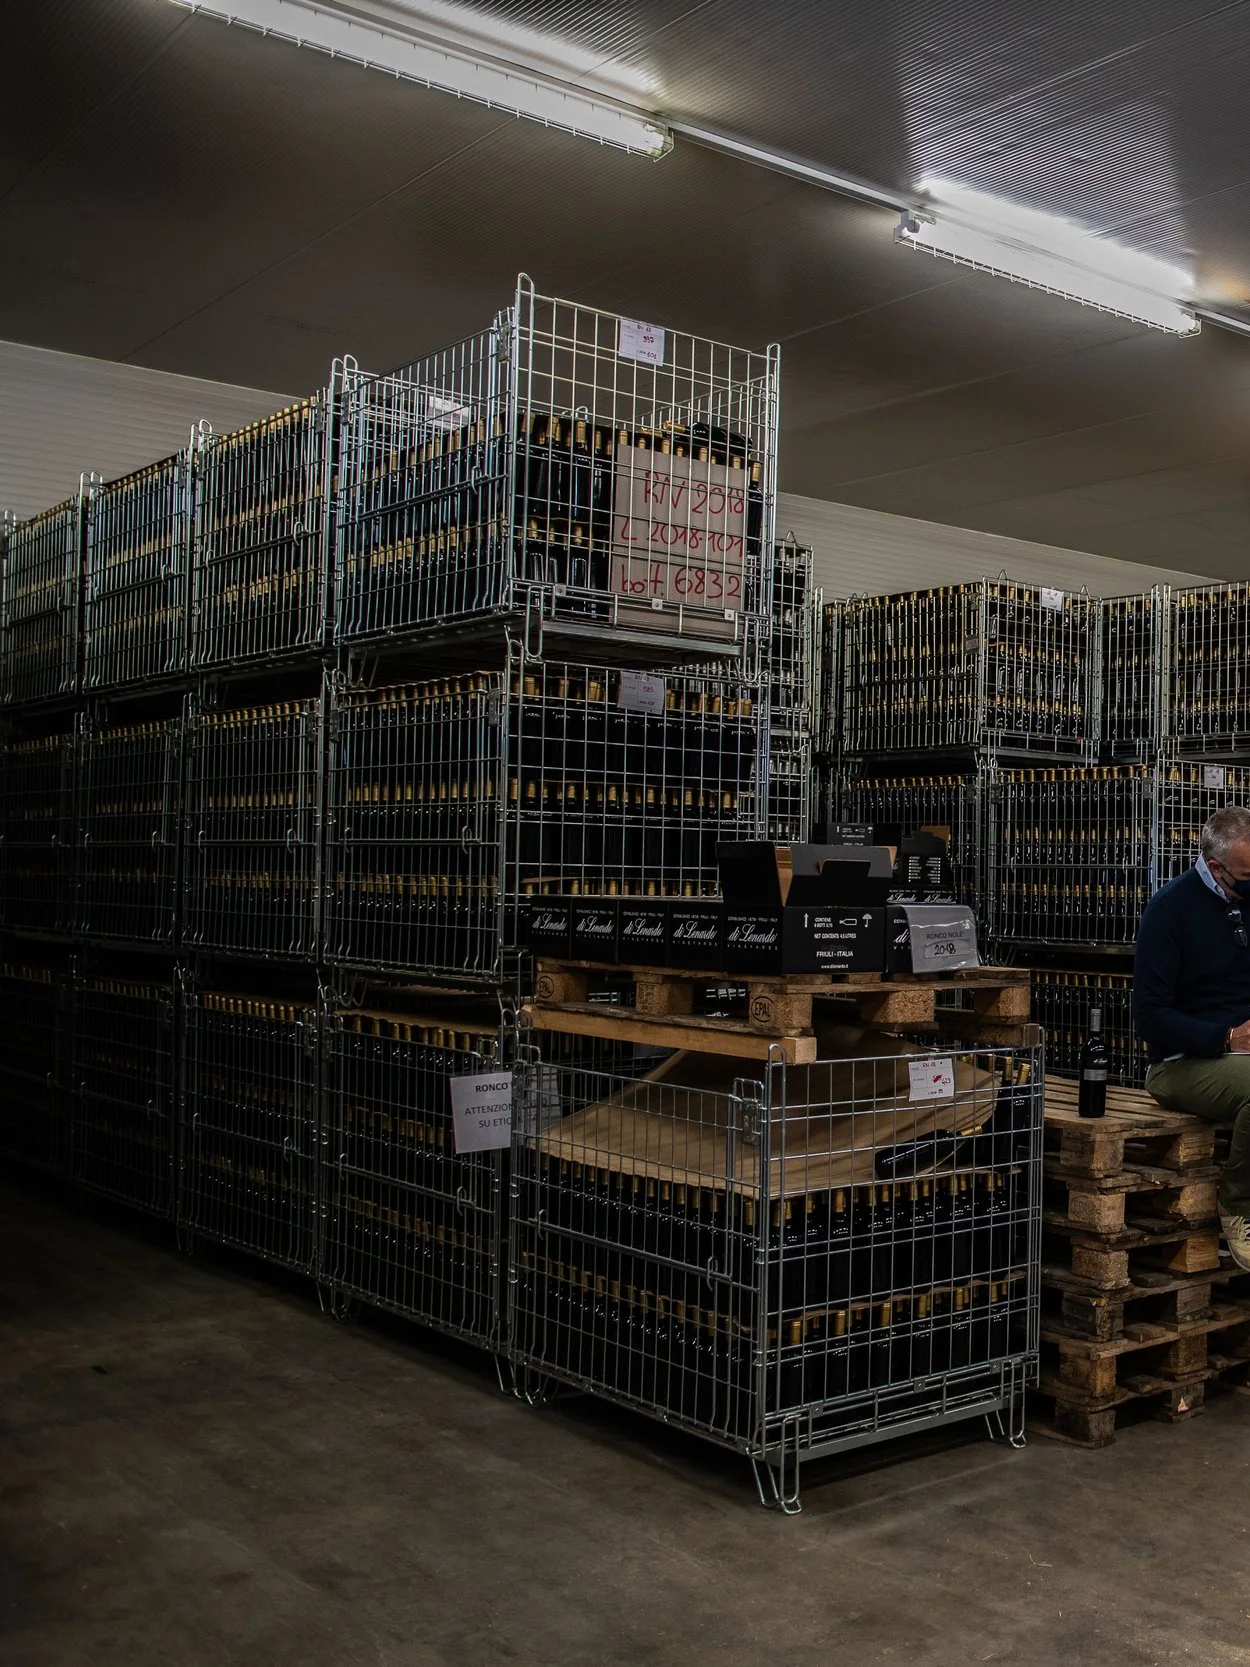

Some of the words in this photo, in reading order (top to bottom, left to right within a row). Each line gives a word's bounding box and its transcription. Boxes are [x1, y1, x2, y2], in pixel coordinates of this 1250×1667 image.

[692, 483, 744, 514] 2018
[675, 567, 742, 599] 6832
[532, 916, 541, 929] di
[540, 913, 568, 931] Lenardo
[576, 918, 586, 932] di
[584, 916, 614, 934] Lenardo
[623, 920, 633, 935] di
[632, 918, 665, 937] Lenardo
[673, 923, 685, 938] di
[683, 920, 718, 940] Lenardo
[727, 926, 741, 942] di
[738, 923, 778, 943] Lenardo
[893, 928, 909, 944] di
[926, 932, 948, 940] RONCO
[934, 942, 956, 956] 2018
[475, 1082, 509, 1093] RONCO
[478, 1119, 491, 1128] SU
